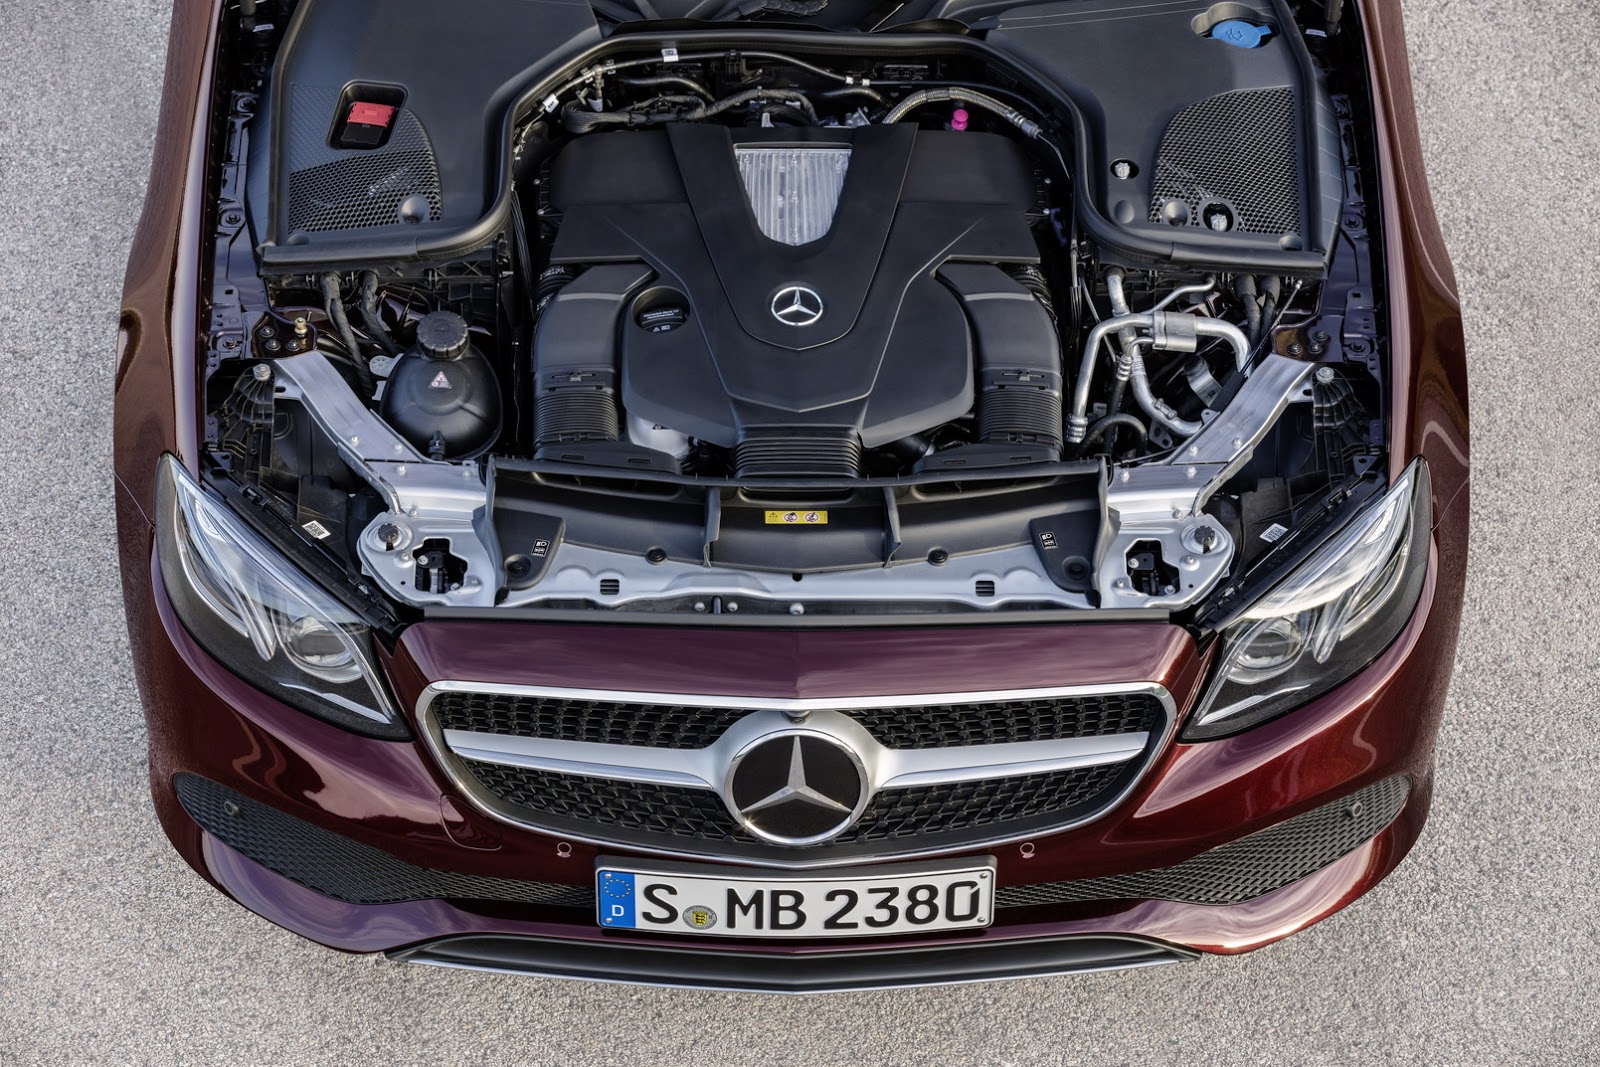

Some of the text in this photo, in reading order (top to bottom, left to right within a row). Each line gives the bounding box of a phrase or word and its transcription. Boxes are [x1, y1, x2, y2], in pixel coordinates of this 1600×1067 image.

[611, 904, 625, 917] D
[642, 883, 679, 925] S
[726, 888, 807, 931] MB
[823, 880, 981, 930] 2380
